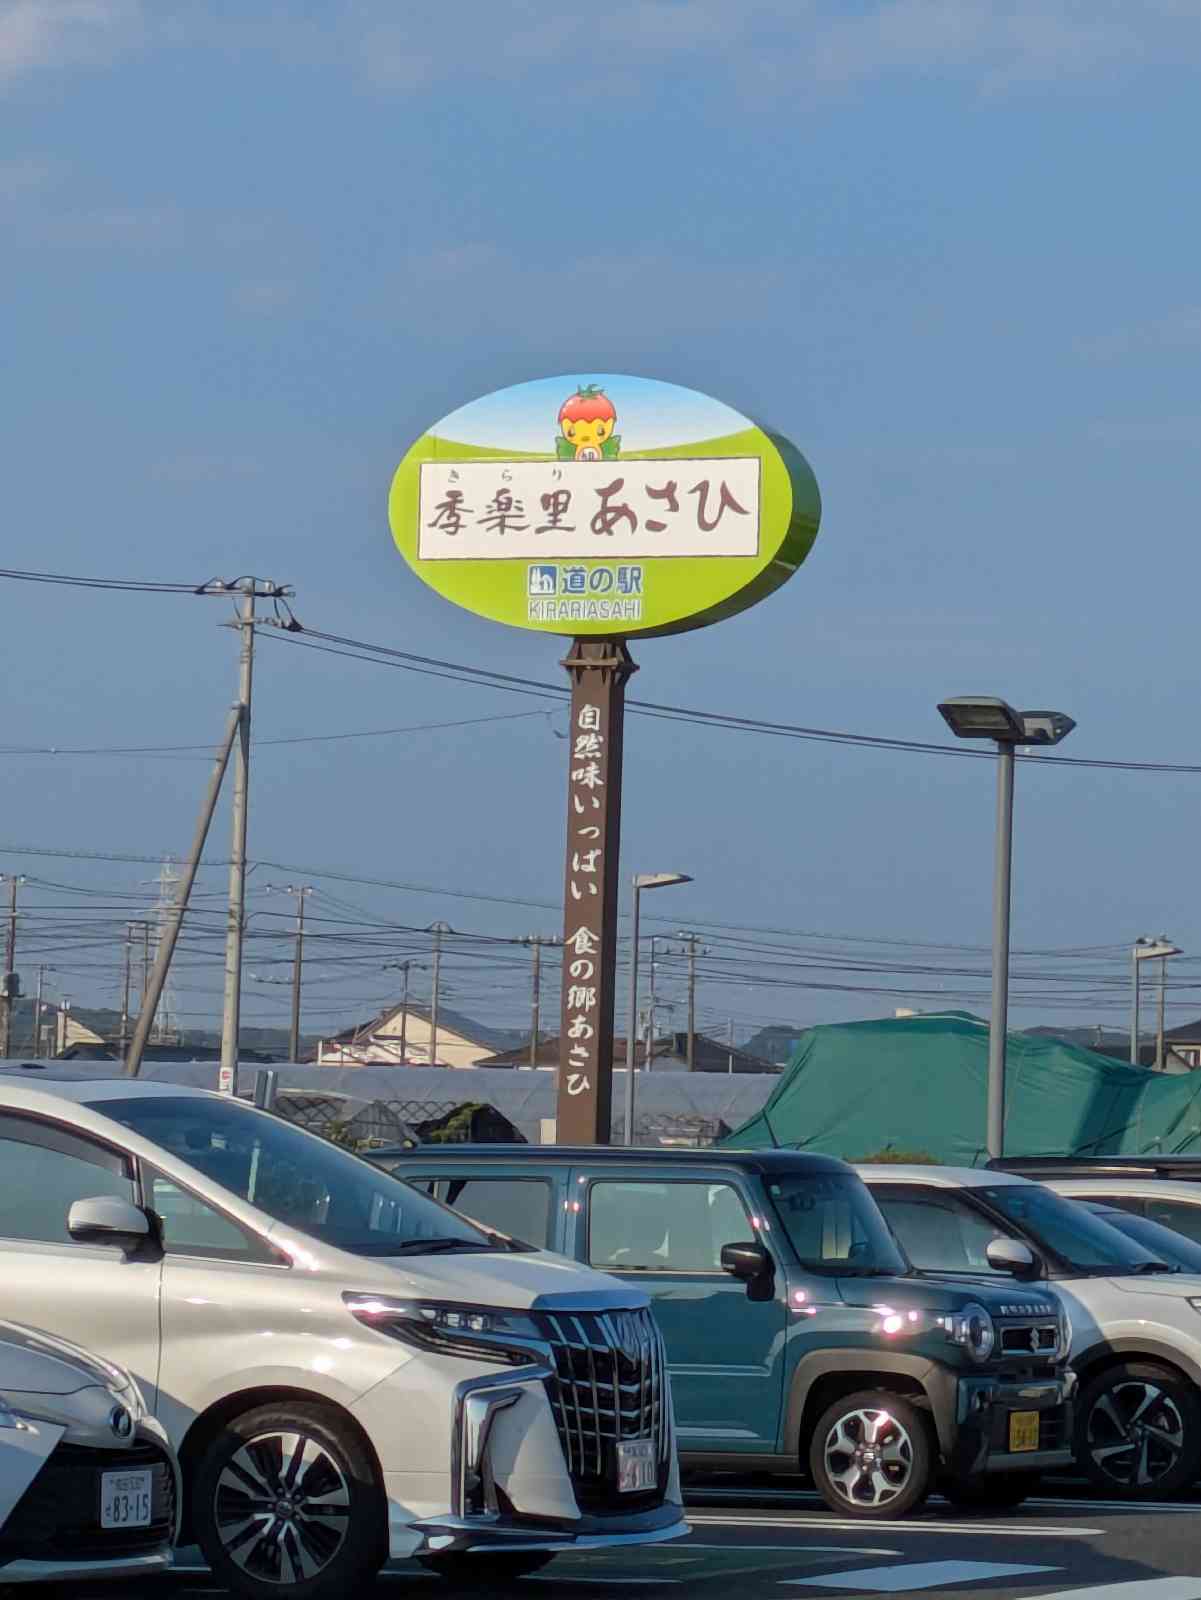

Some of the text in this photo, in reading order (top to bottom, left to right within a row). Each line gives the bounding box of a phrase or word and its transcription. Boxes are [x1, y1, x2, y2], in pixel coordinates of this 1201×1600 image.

[561, 566, 642, 594] 道の駅
[528, 600, 642, 619] KIRARIASAHI
